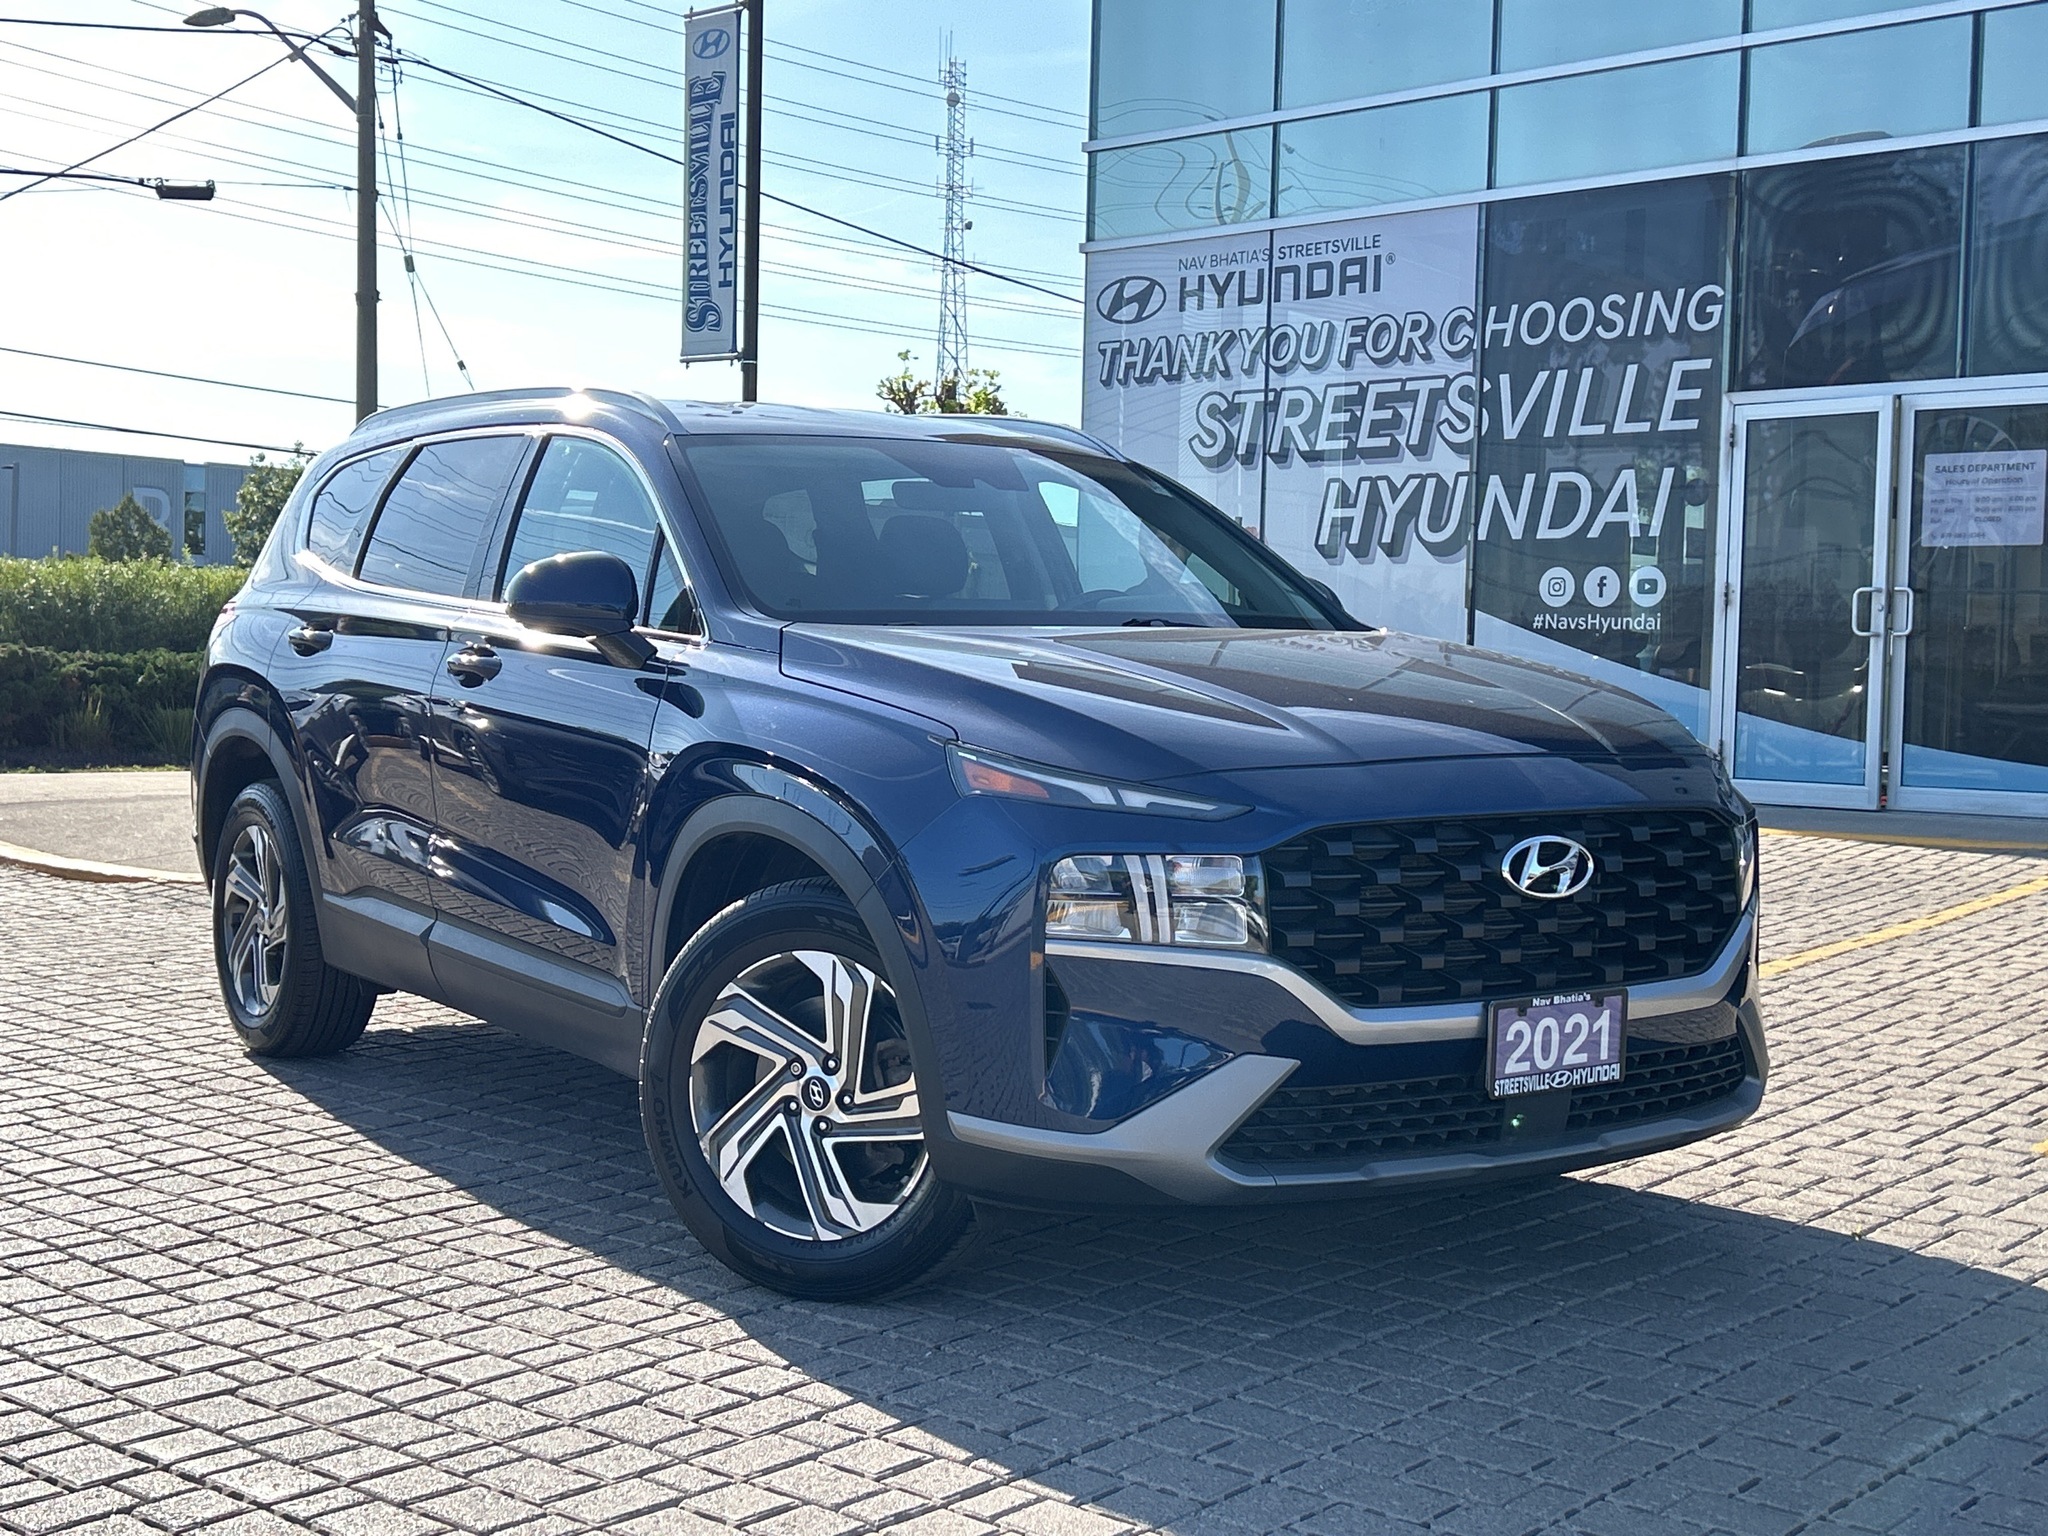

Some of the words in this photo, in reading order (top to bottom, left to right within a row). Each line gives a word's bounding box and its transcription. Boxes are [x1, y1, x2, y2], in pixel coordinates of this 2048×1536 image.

[685, 71, 727, 332] STREETSVILLE
[718, 112, 736, 289] HYUNDAI
[1178, 255, 1208, 272] NAV
[1210, 247, 1273, 268] BHATIA'S
[1278, 234, 1382, 260] STREETSVILLE
[1178, 254, 1383, 312] HYUNDAI
[1097, 330, 1240, 390] THANK
[1238, 320, 1342, 378] YOU
[1338, 310, 1440, 370] FOR
[1439, 284, 1725, 360] CHOOSING
[1190, 358, 1713, 472] STREETSVILLE
[1934, 464, 1966, 474] SALES
[1967, 462, 2037, 473] DEPARTMENT
[1315, 466, 1675, 560] HYUNDAI
[1533, 613, 1661, 633] #NavsHyundai
[1532, 997, 1551, 1007] Nav
[1553, 992, 1591, 1004] Bhatia's
[1504, 1009, 1611, 1075] 2021
[1494, 1074, 1550, 1097] STREETSVILLE
[1572, 1063, 1621, 1086] HYUNDAI
